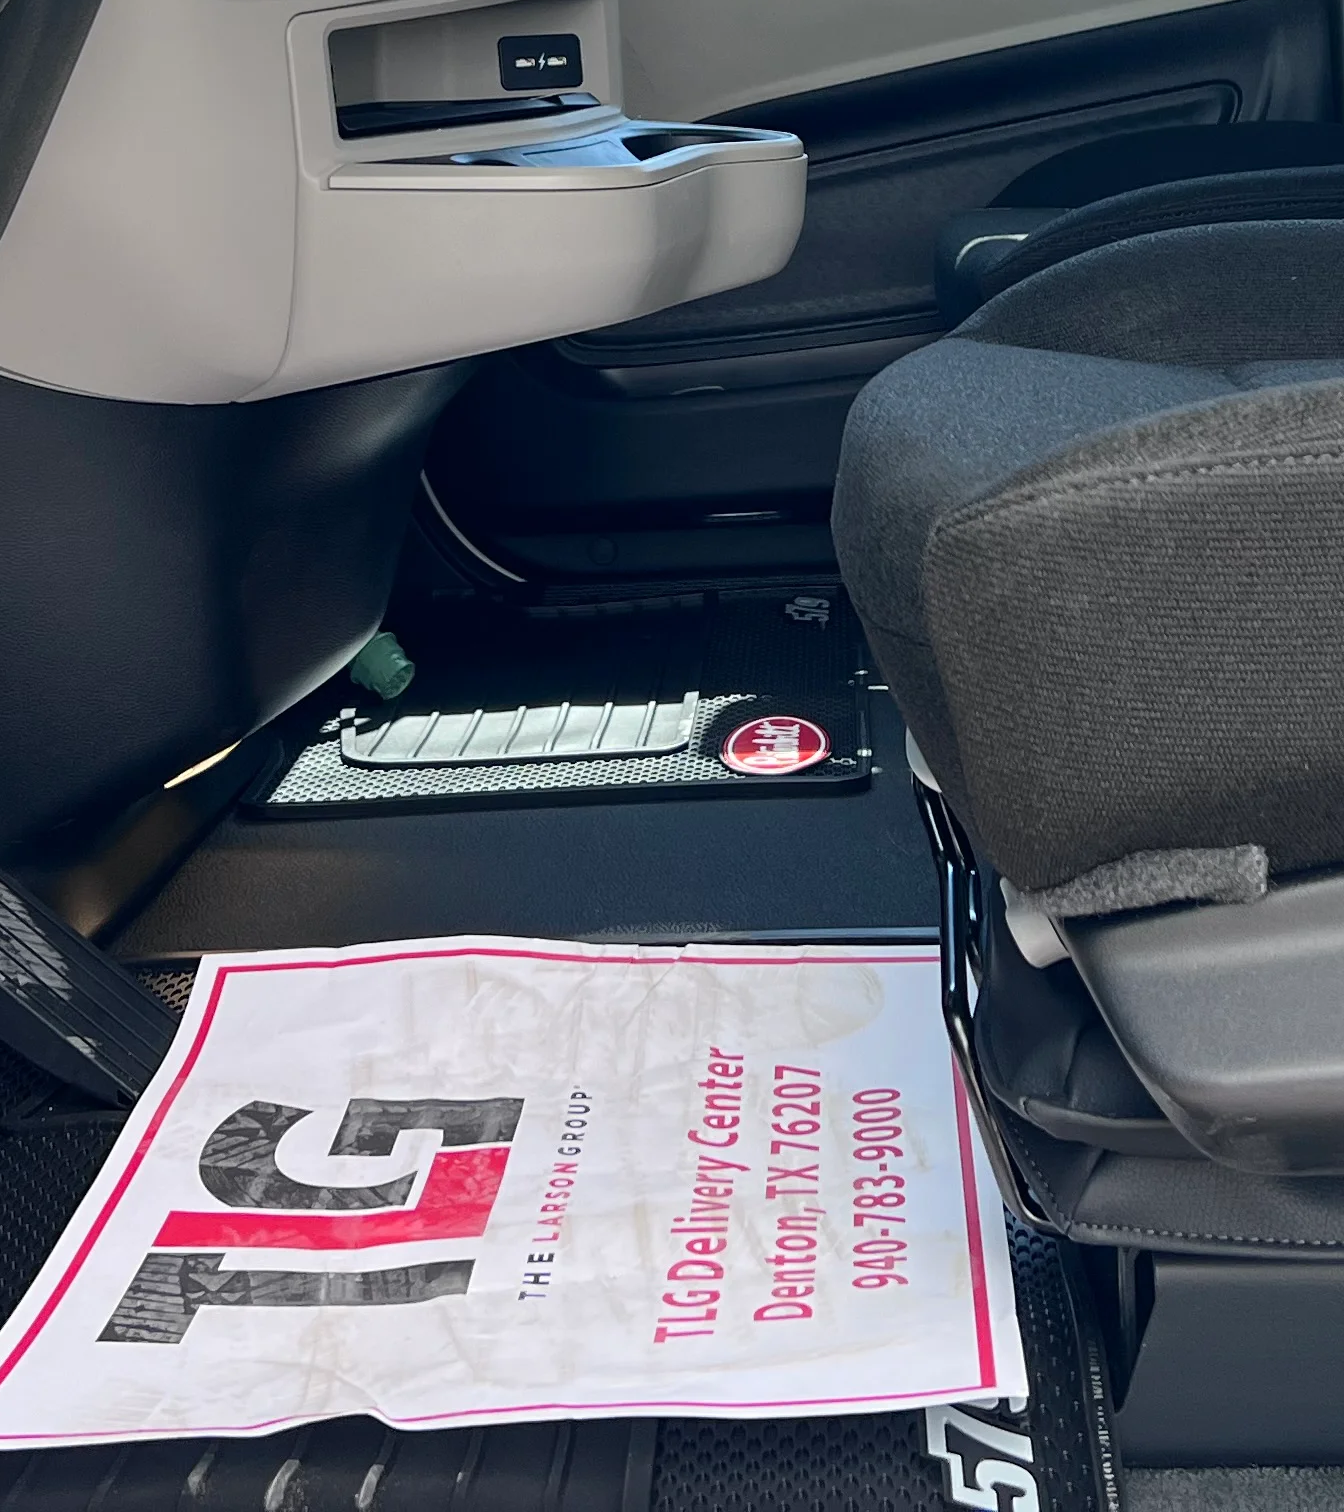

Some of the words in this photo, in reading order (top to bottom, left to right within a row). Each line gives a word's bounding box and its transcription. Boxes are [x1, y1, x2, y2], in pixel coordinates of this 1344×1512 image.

[557, 1090, 592, 1156] GROUP
[687, 1046, 744, 1147] Center
[770, 1065, 822, 1154] 76207
[95, 1097, 525, 1344] TLG
[532, 1162, 579, 1242] LARSON
[667, 1155, 751, 1281] Delivery
[765, 1164, 820, 1199] TX
[852, 1088, 909, 1289] 940-783-9000
[518, 1252, 555, 1300] THE
[753, 1207, 827, 1321] Denton,
[654, 1290, 721, 1343] TLG
